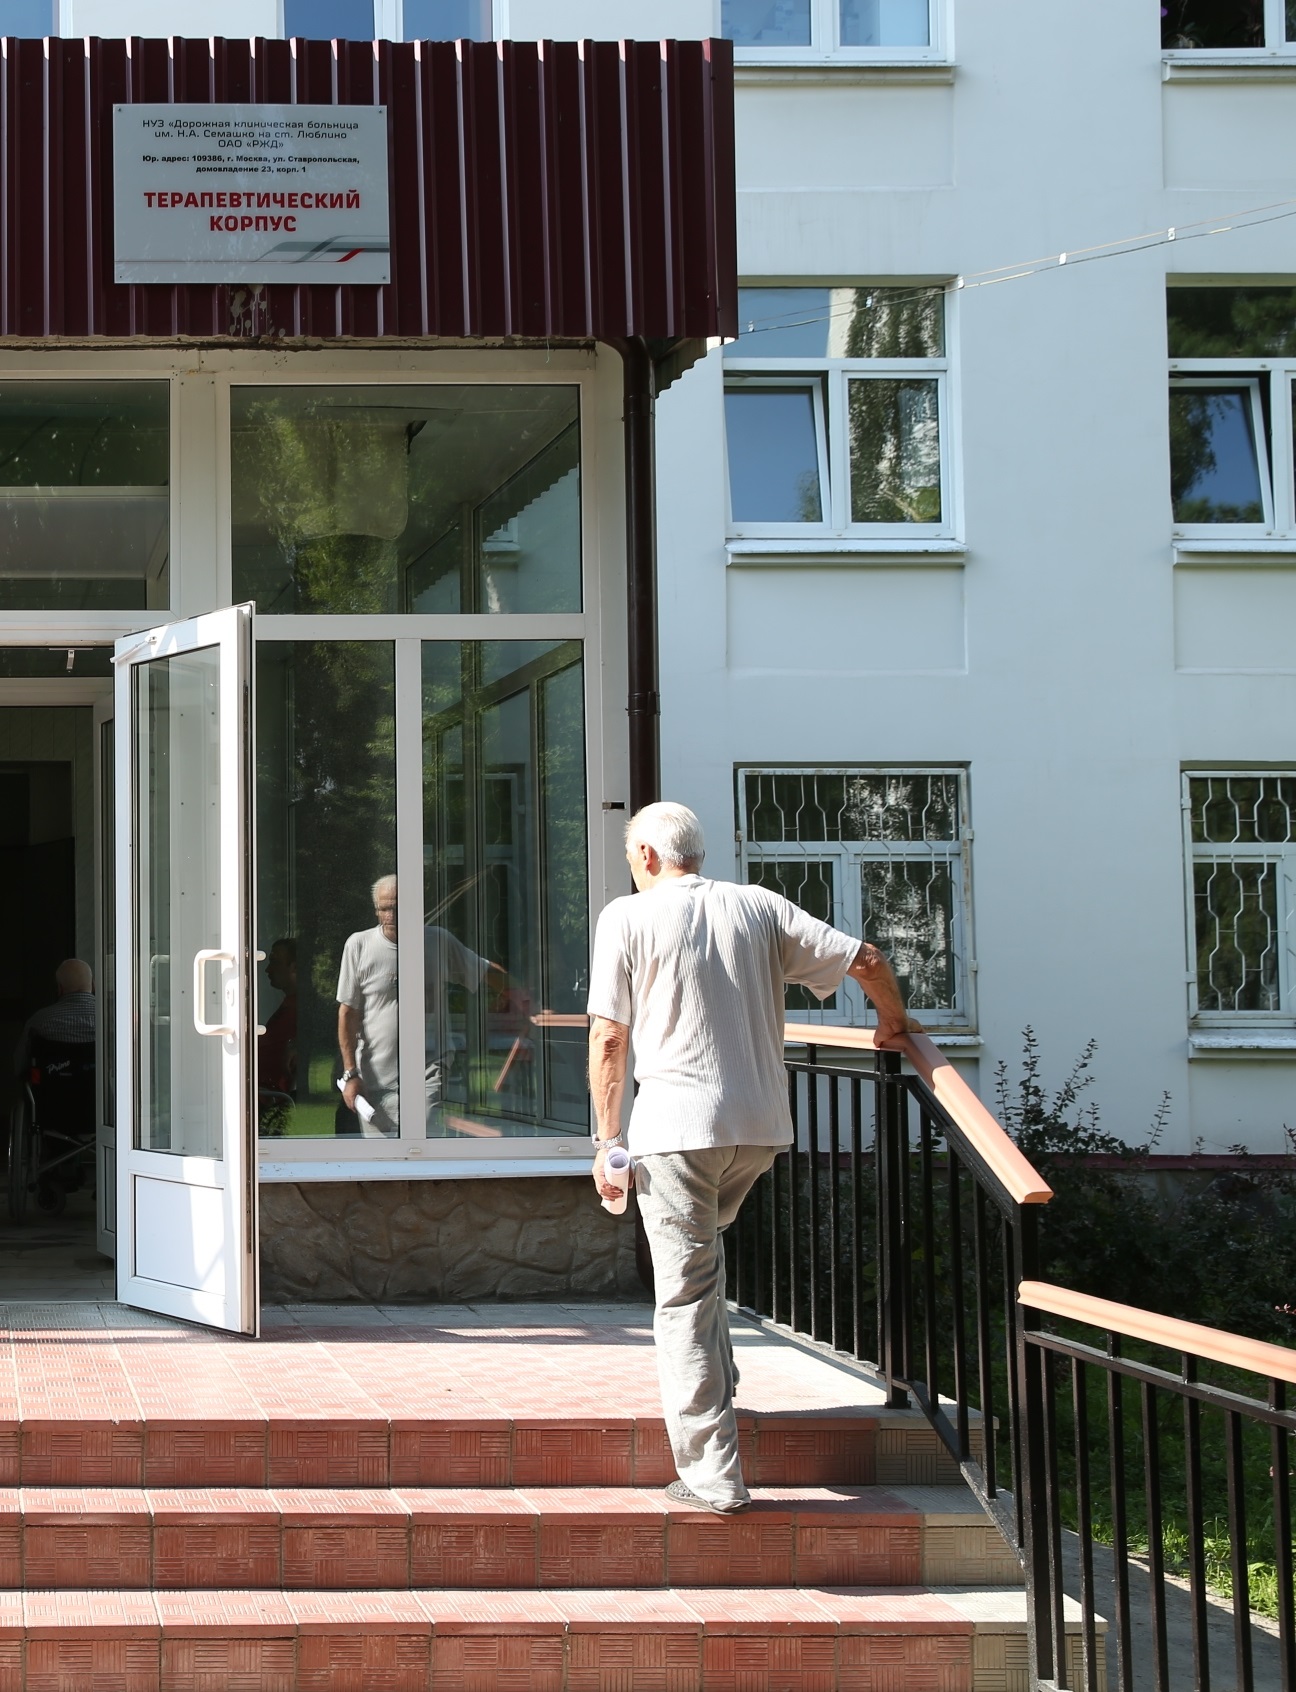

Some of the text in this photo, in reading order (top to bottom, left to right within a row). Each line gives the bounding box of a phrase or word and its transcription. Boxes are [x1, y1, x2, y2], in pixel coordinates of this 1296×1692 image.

[142, 119, 359, 131] НУЗ «Дорожная клиническая больница
[177, 129, 200, 138] Н.А.
[203, 129, 255, 139] Семашко
[258, 131, 271, 139] на
[274, 131, 294, 139] ст.
[296, 130, 347, 140] Люблино
[217, 139, 284, 150] ОАО «РЖД»
[142, 154, 160, 164] Юр.
[161, 156, 190, 164] адрес:
[191, 154, 225, 163] 109386,
[235, 155, 271, 164] Москва,
[272, 156, 286, 164] ул.
[287, 155, 360, 165] Ставропольская,
[195, 166, 260, 174] домовладение
[260, 165, 275, 174] 23,
[276, 167, 300, 175] корп.
[144, 190, 359, 208] ТЕРАПЕВТИЧЕСКИЙ
[210, 216, 296, 232] КОРПУС
